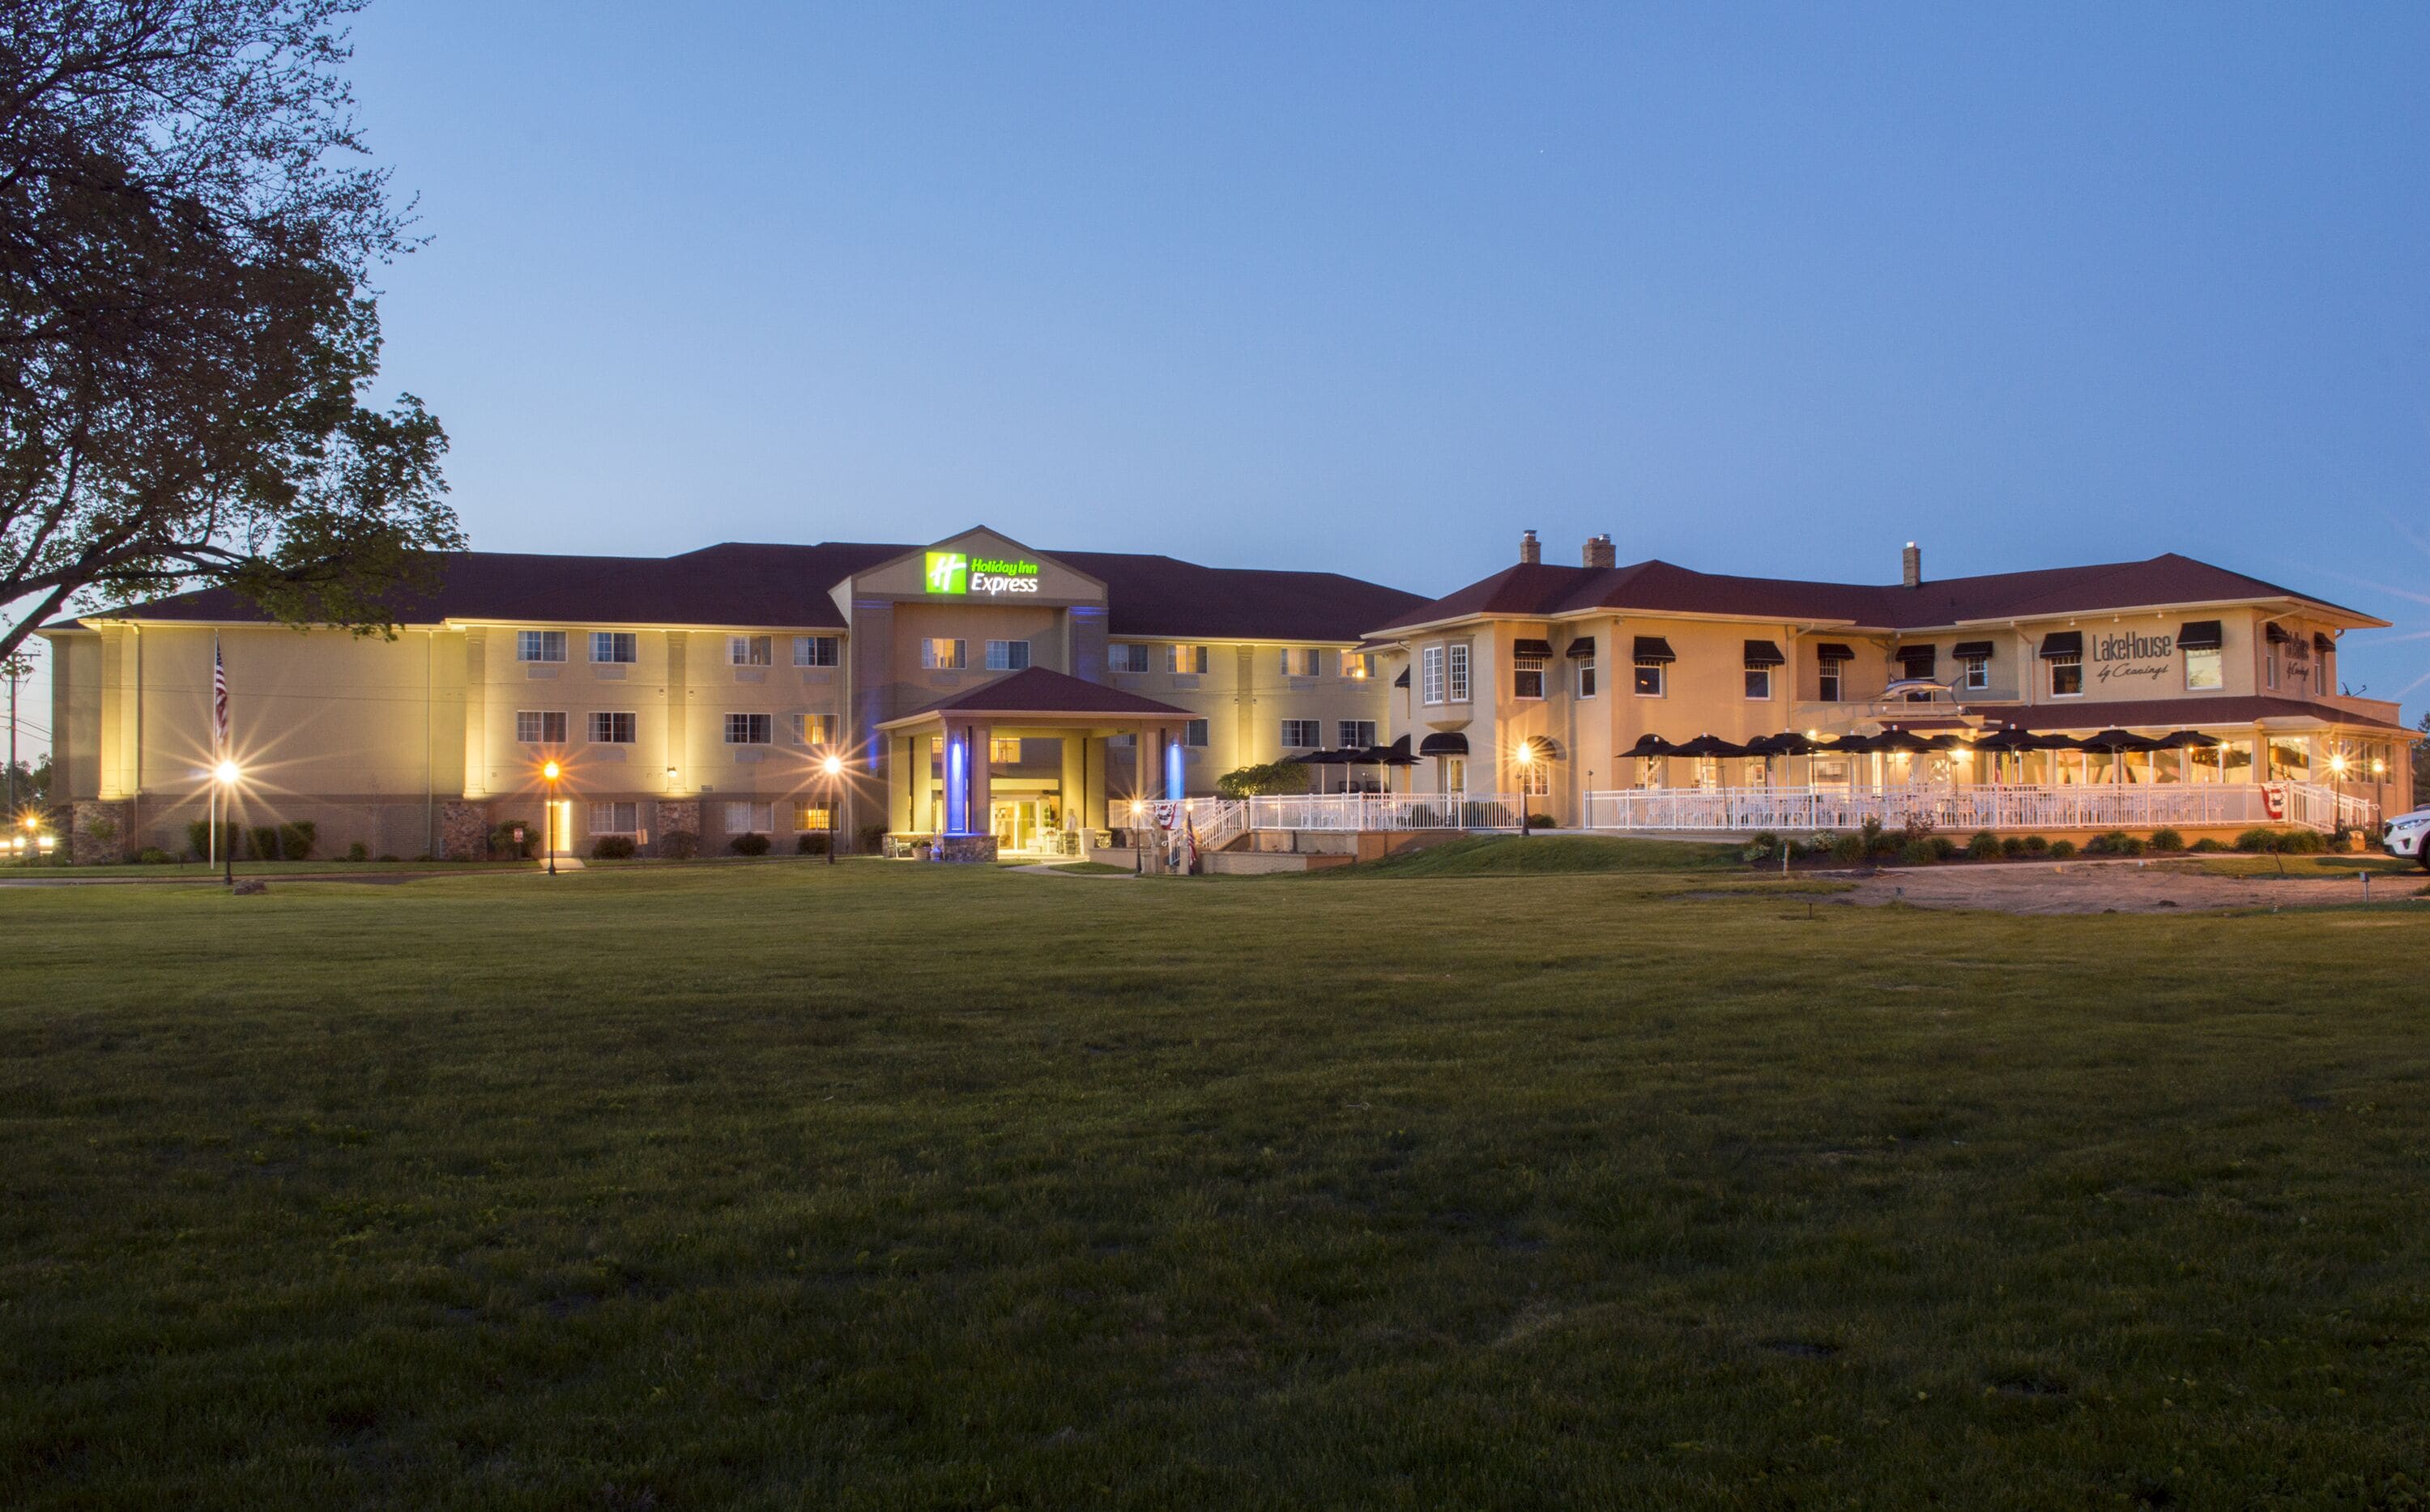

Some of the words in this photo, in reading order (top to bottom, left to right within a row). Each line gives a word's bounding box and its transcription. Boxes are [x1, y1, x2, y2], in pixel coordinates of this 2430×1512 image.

[971, 558, 1017, 576] Holiday
[1018, 560, 1038, 574] Inn
[971, 572, 1038, 595] Express
[2092, 631, 2172, 662] LakeHouse
[2097, 664, 2111, 683] by
[2112, 662, 2169, 680] Cravings
